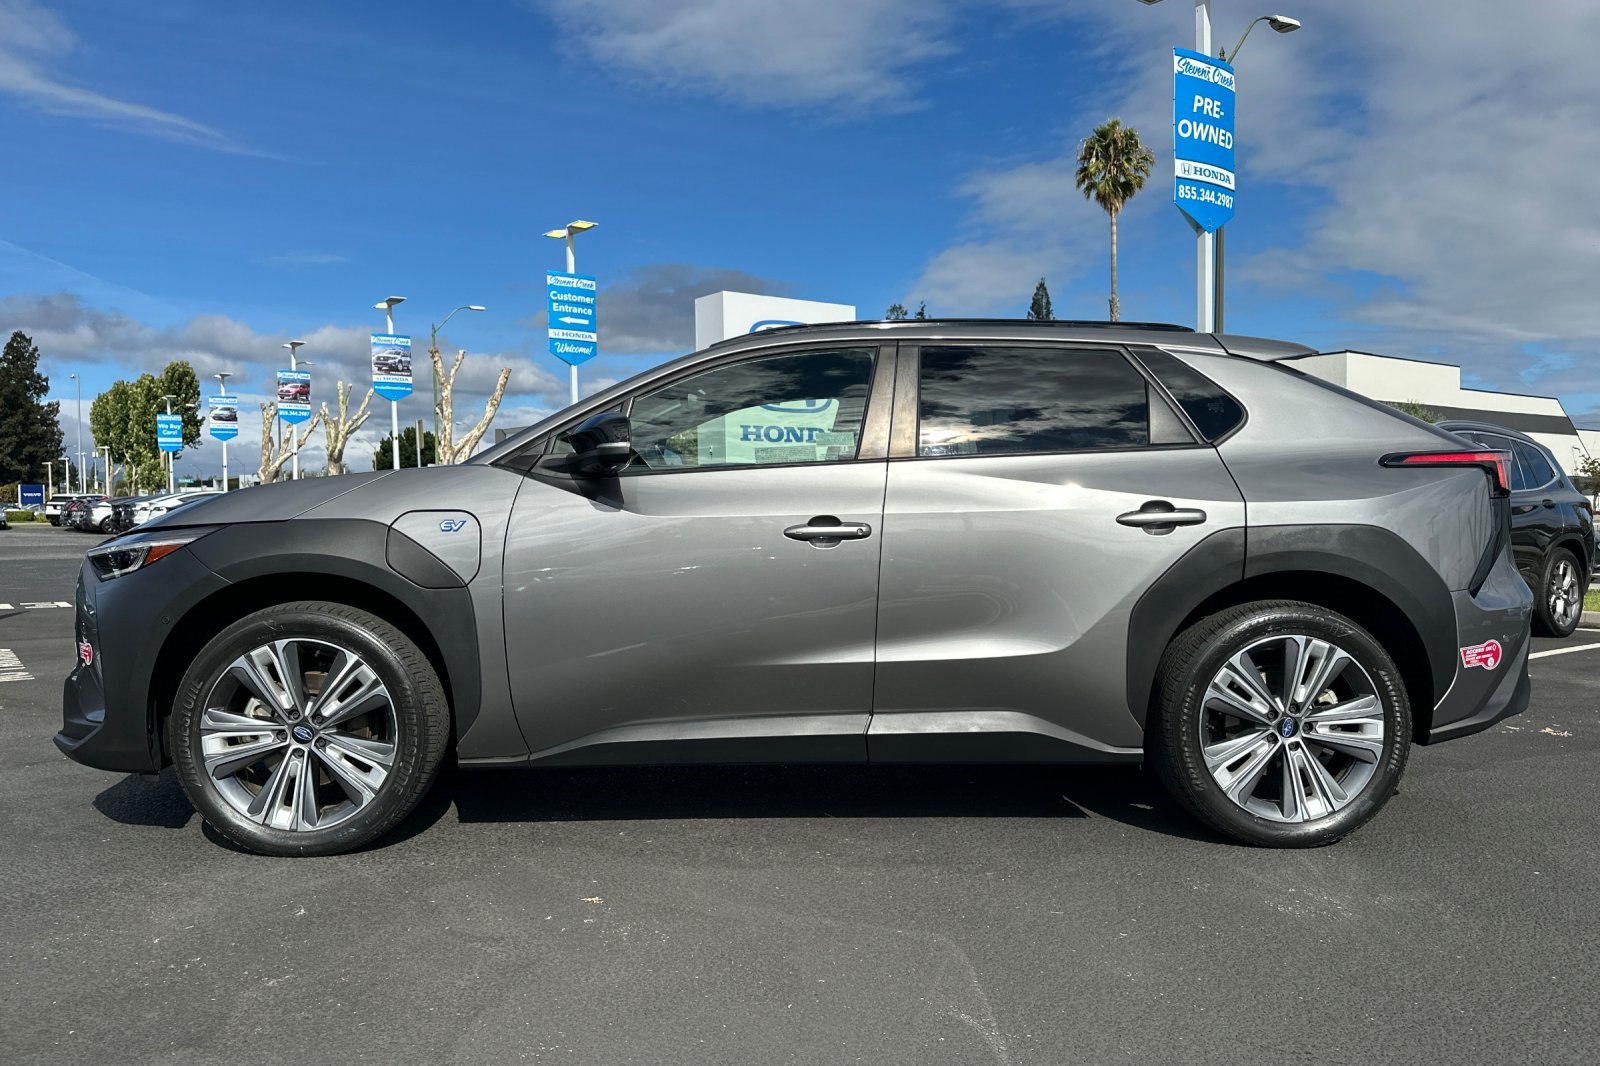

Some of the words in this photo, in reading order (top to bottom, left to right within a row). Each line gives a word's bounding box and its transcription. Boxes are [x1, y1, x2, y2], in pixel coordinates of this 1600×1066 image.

[1213, 67, 1234, 88] Creek
[1193, 94, 1225, 119] PRE-
[1177, 119, 1234, 150] OWNED
[1193, 166, 1232, 184] HONDA
[1178, 185, 1234, 209] 855.344.2987
[549, 290, 595, 304] Customer
[552, 302, 593, 316] Entrance
[561, 331, 593, 340] HONDA
[554, 342, 593, 355] Welcome!
[740, 425, 834, 443] HOND
[439, 519, 467, 532] EV
